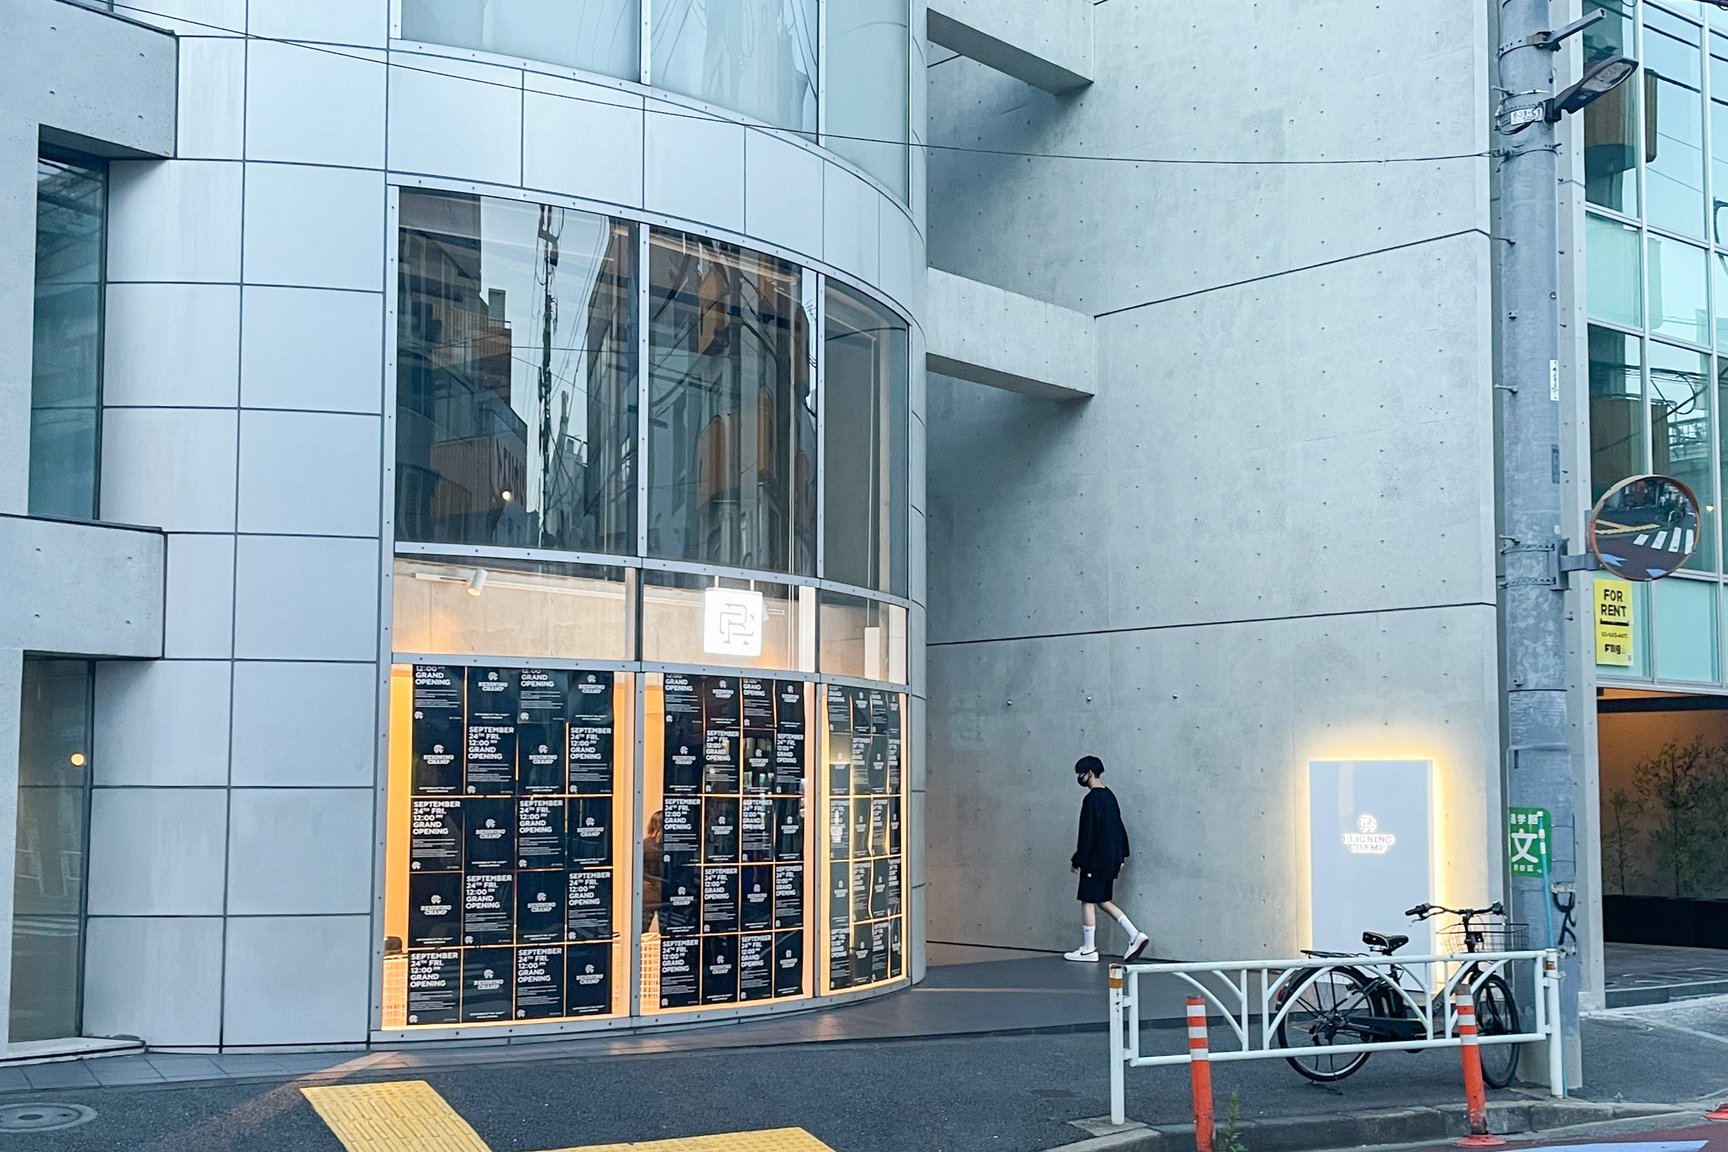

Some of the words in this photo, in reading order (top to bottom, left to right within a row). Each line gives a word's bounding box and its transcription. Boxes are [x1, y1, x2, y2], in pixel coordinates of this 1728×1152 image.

[1604, 589, 1623, 602] FOR
[1601, 604, 1626, 617] RENT
[1511, 828, 1539, 863] 文
[410, 952, 458, 960] SEPTEMBER
[518, 948, 562, 956] SEPTEMBER
[518, 975, 551, 983] OPENING
